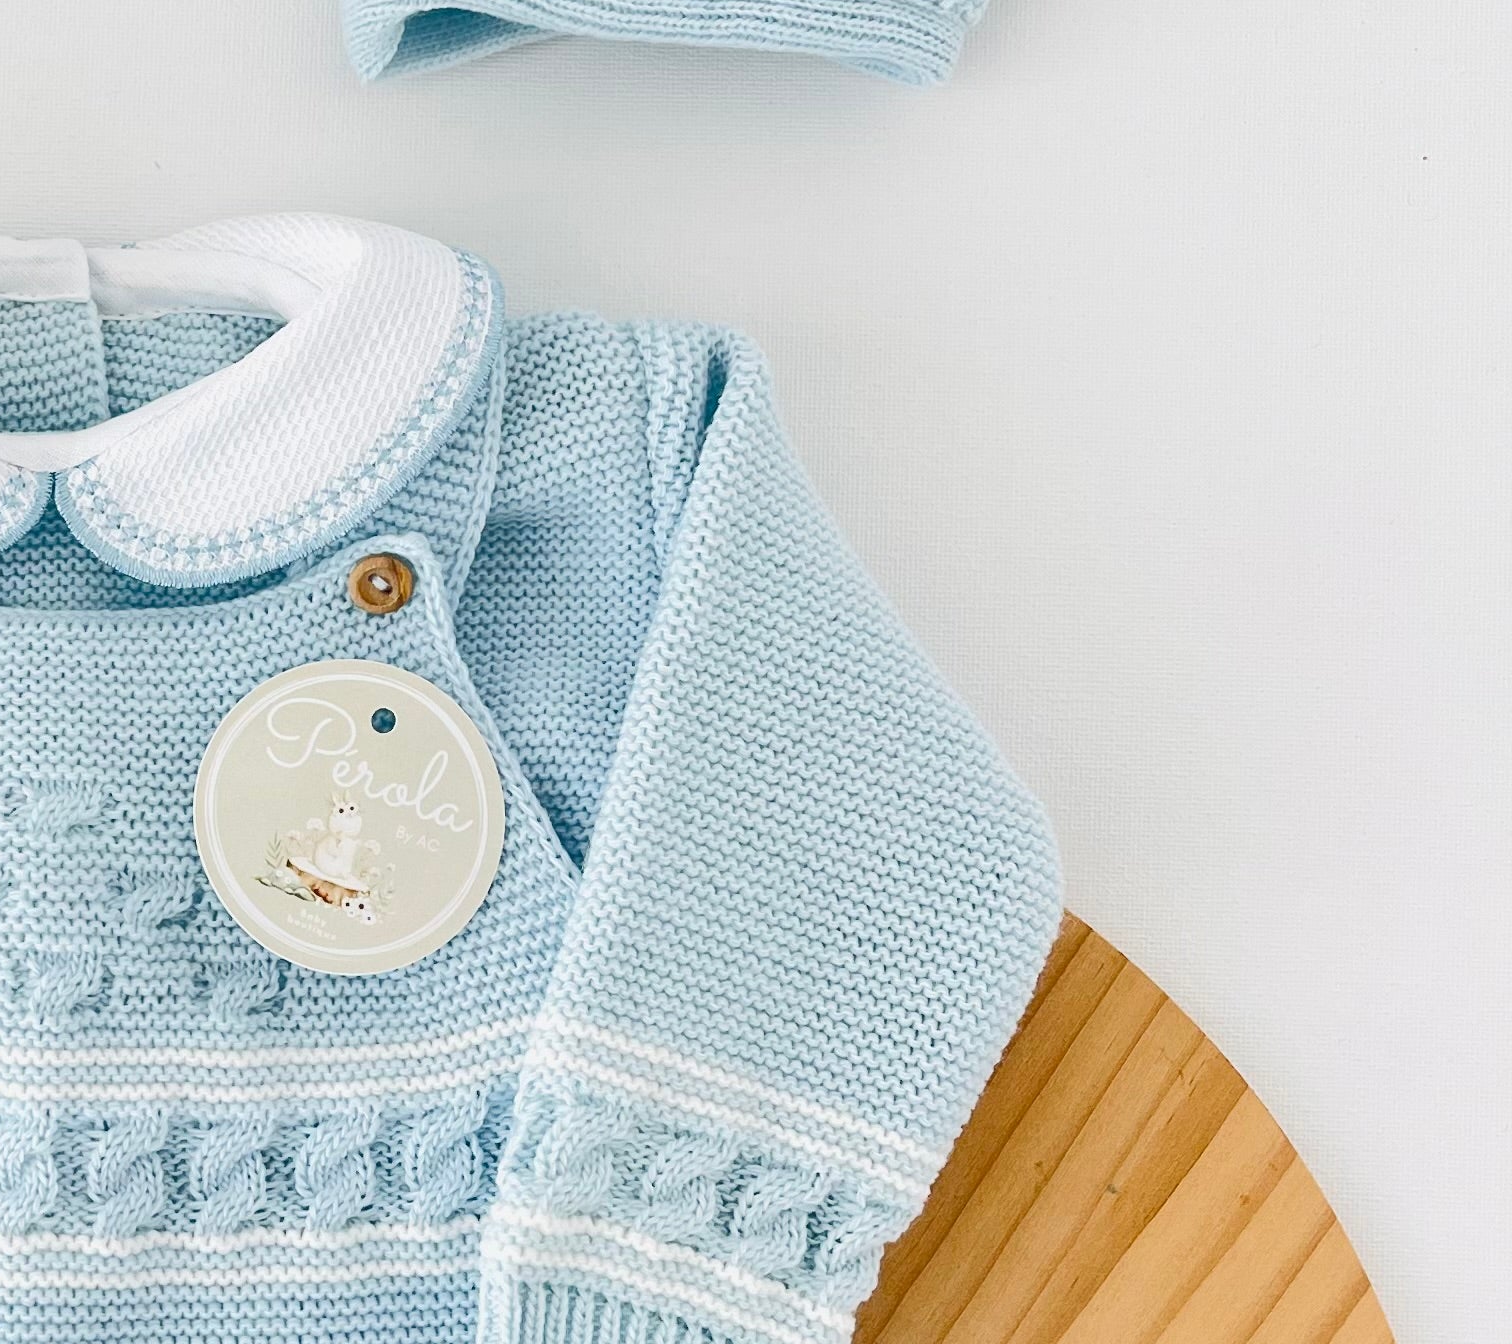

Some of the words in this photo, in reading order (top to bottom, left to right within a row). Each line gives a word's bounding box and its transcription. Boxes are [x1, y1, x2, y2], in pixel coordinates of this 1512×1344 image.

[266, 697, 474, 832] Pérola
[396, 825, 414, 844] By
[416, 834, 441, 853] AC
